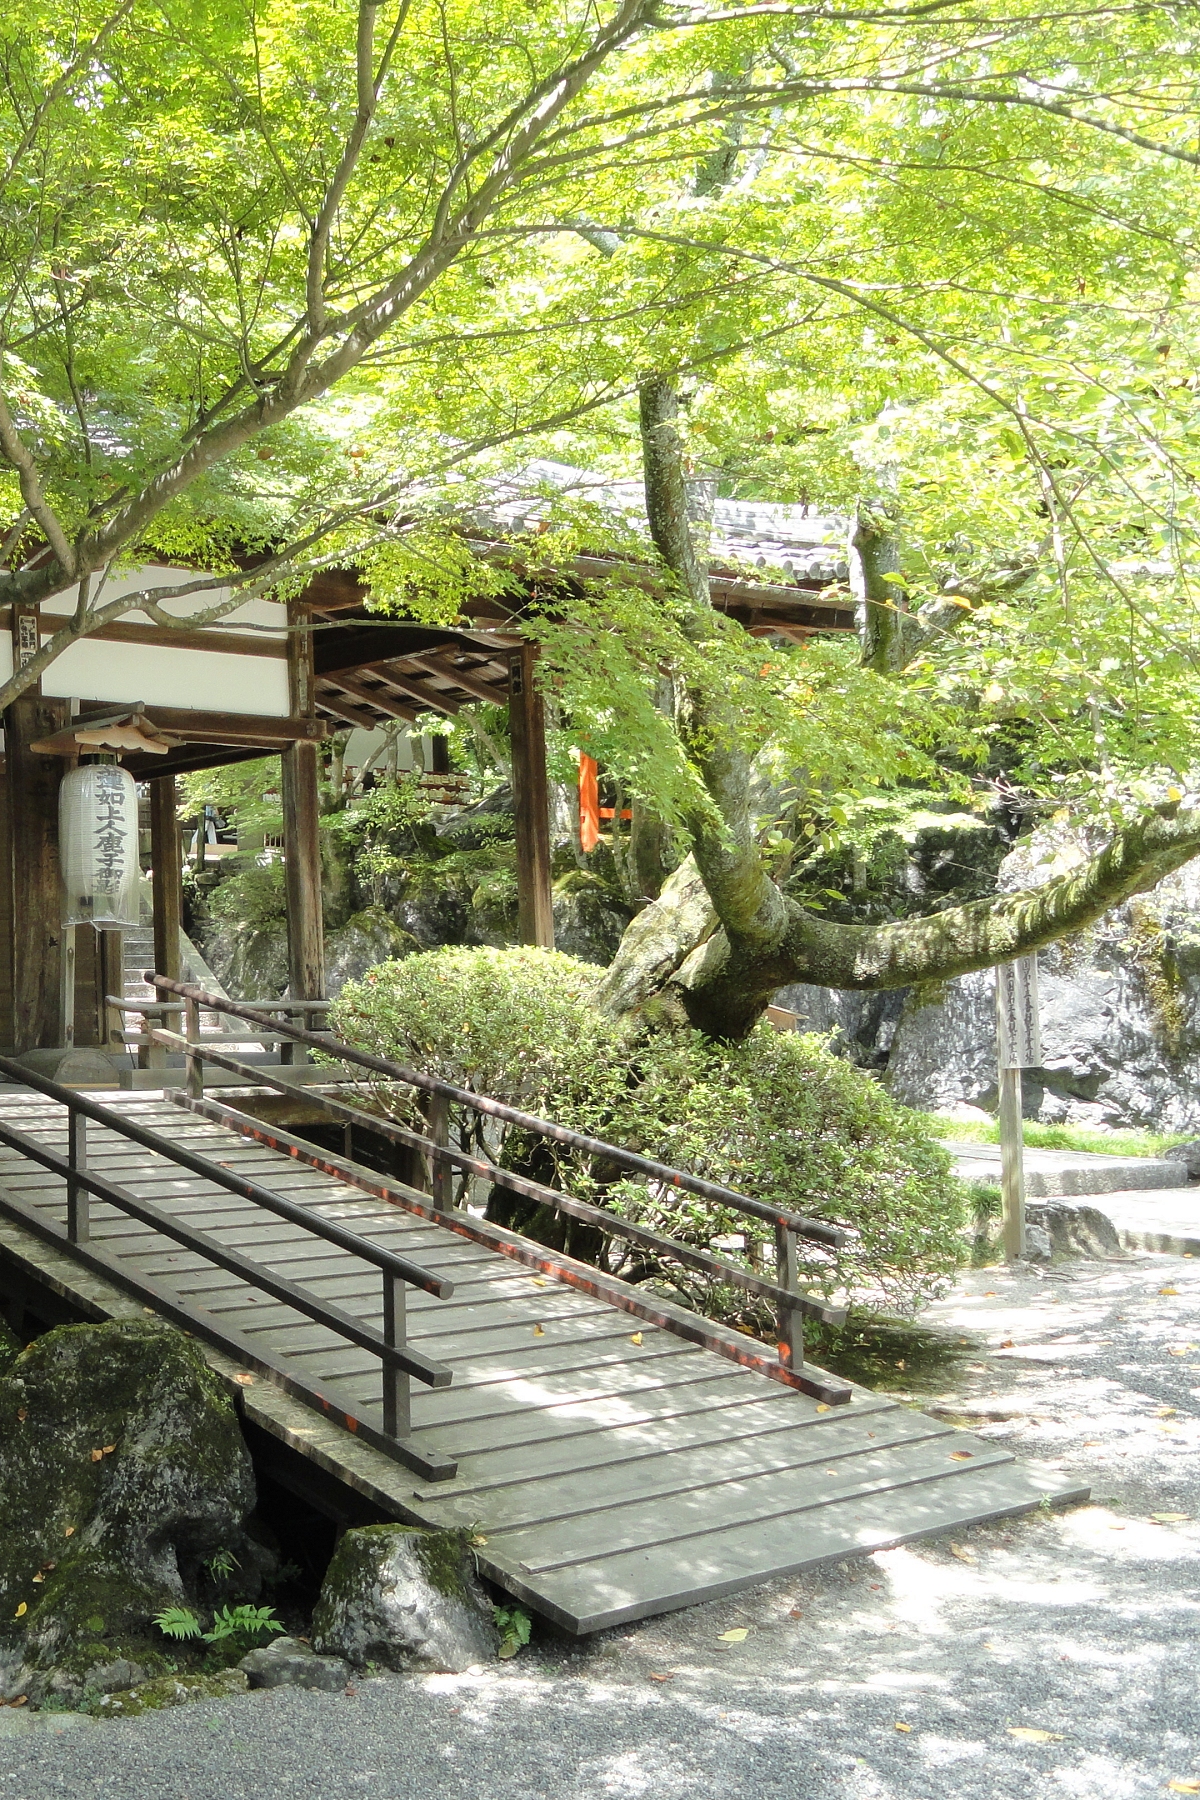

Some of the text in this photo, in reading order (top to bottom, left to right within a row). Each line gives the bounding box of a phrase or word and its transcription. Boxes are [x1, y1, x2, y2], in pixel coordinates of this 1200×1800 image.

[91, 766, 128, 895] 蓮如上人鹿子御影
